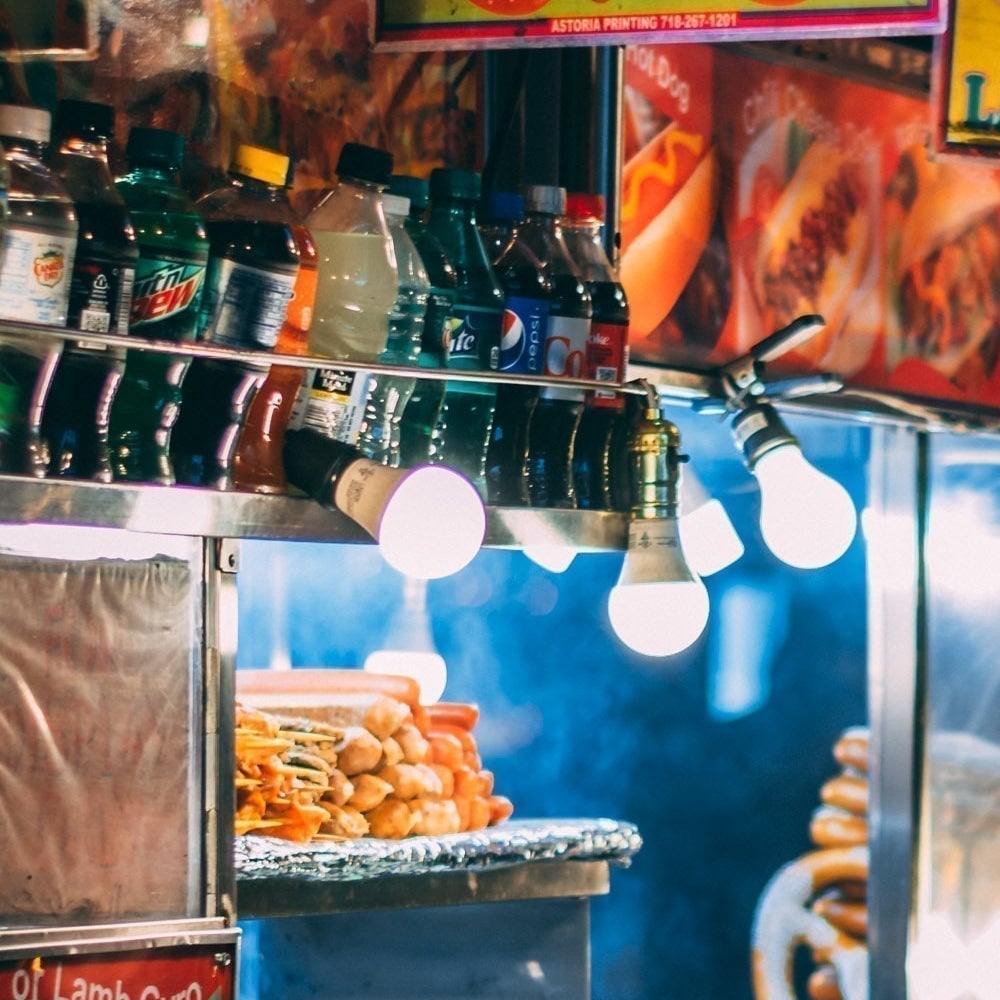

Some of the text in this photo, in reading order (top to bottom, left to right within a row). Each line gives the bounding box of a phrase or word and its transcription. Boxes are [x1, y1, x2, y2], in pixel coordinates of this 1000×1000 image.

[551, 13, 738, 33] ASTORIA PRINTING 718-267-1201
[656, 55, 690, 115] Dog
[526, 306, 542, 371] pepsi
